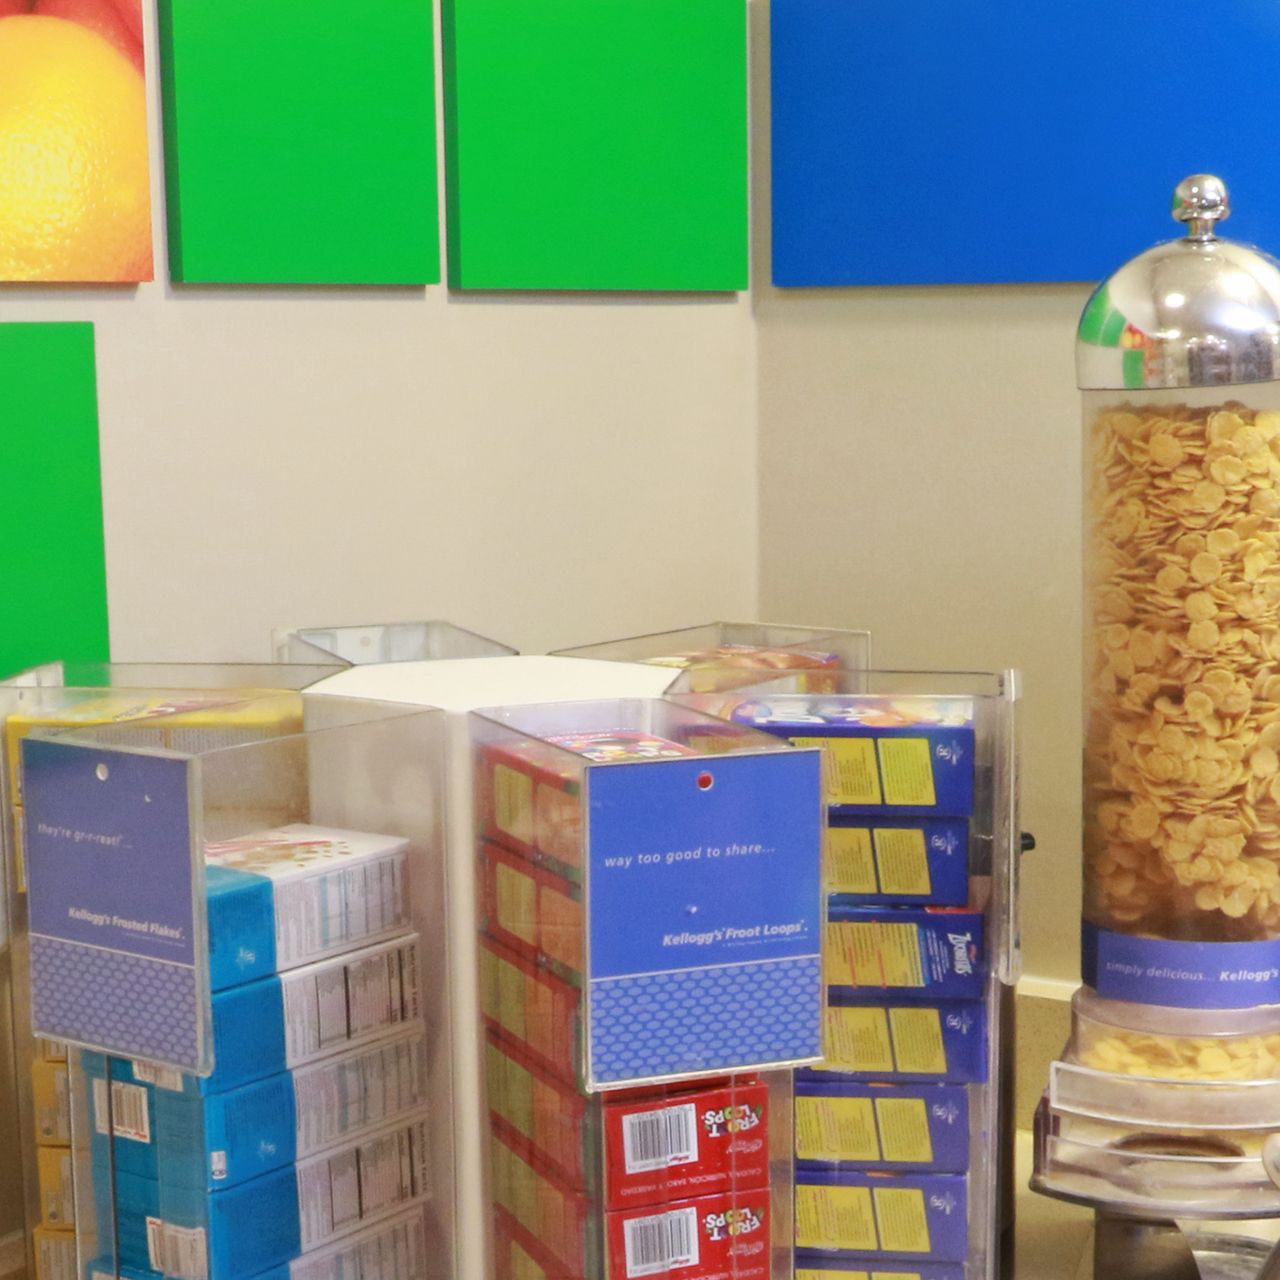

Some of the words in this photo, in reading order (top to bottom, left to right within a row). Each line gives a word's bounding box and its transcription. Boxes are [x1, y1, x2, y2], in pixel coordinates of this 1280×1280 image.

[604, 855, 632, 868] way
[638, 852, 661, 864] too
[666, 846, 702, 865] good
[706, 846, 721, 857] to
[68, 907, 110, 927] Kellogg's
[111, 915, 149, 933] Frosted
[662, 928, 722, 948] Kellogg's
[725, 926, 760, 940] Froot
[1106, 961, 1144, 978] simply
[1219, 967, 1279, 983] Kellogg's
